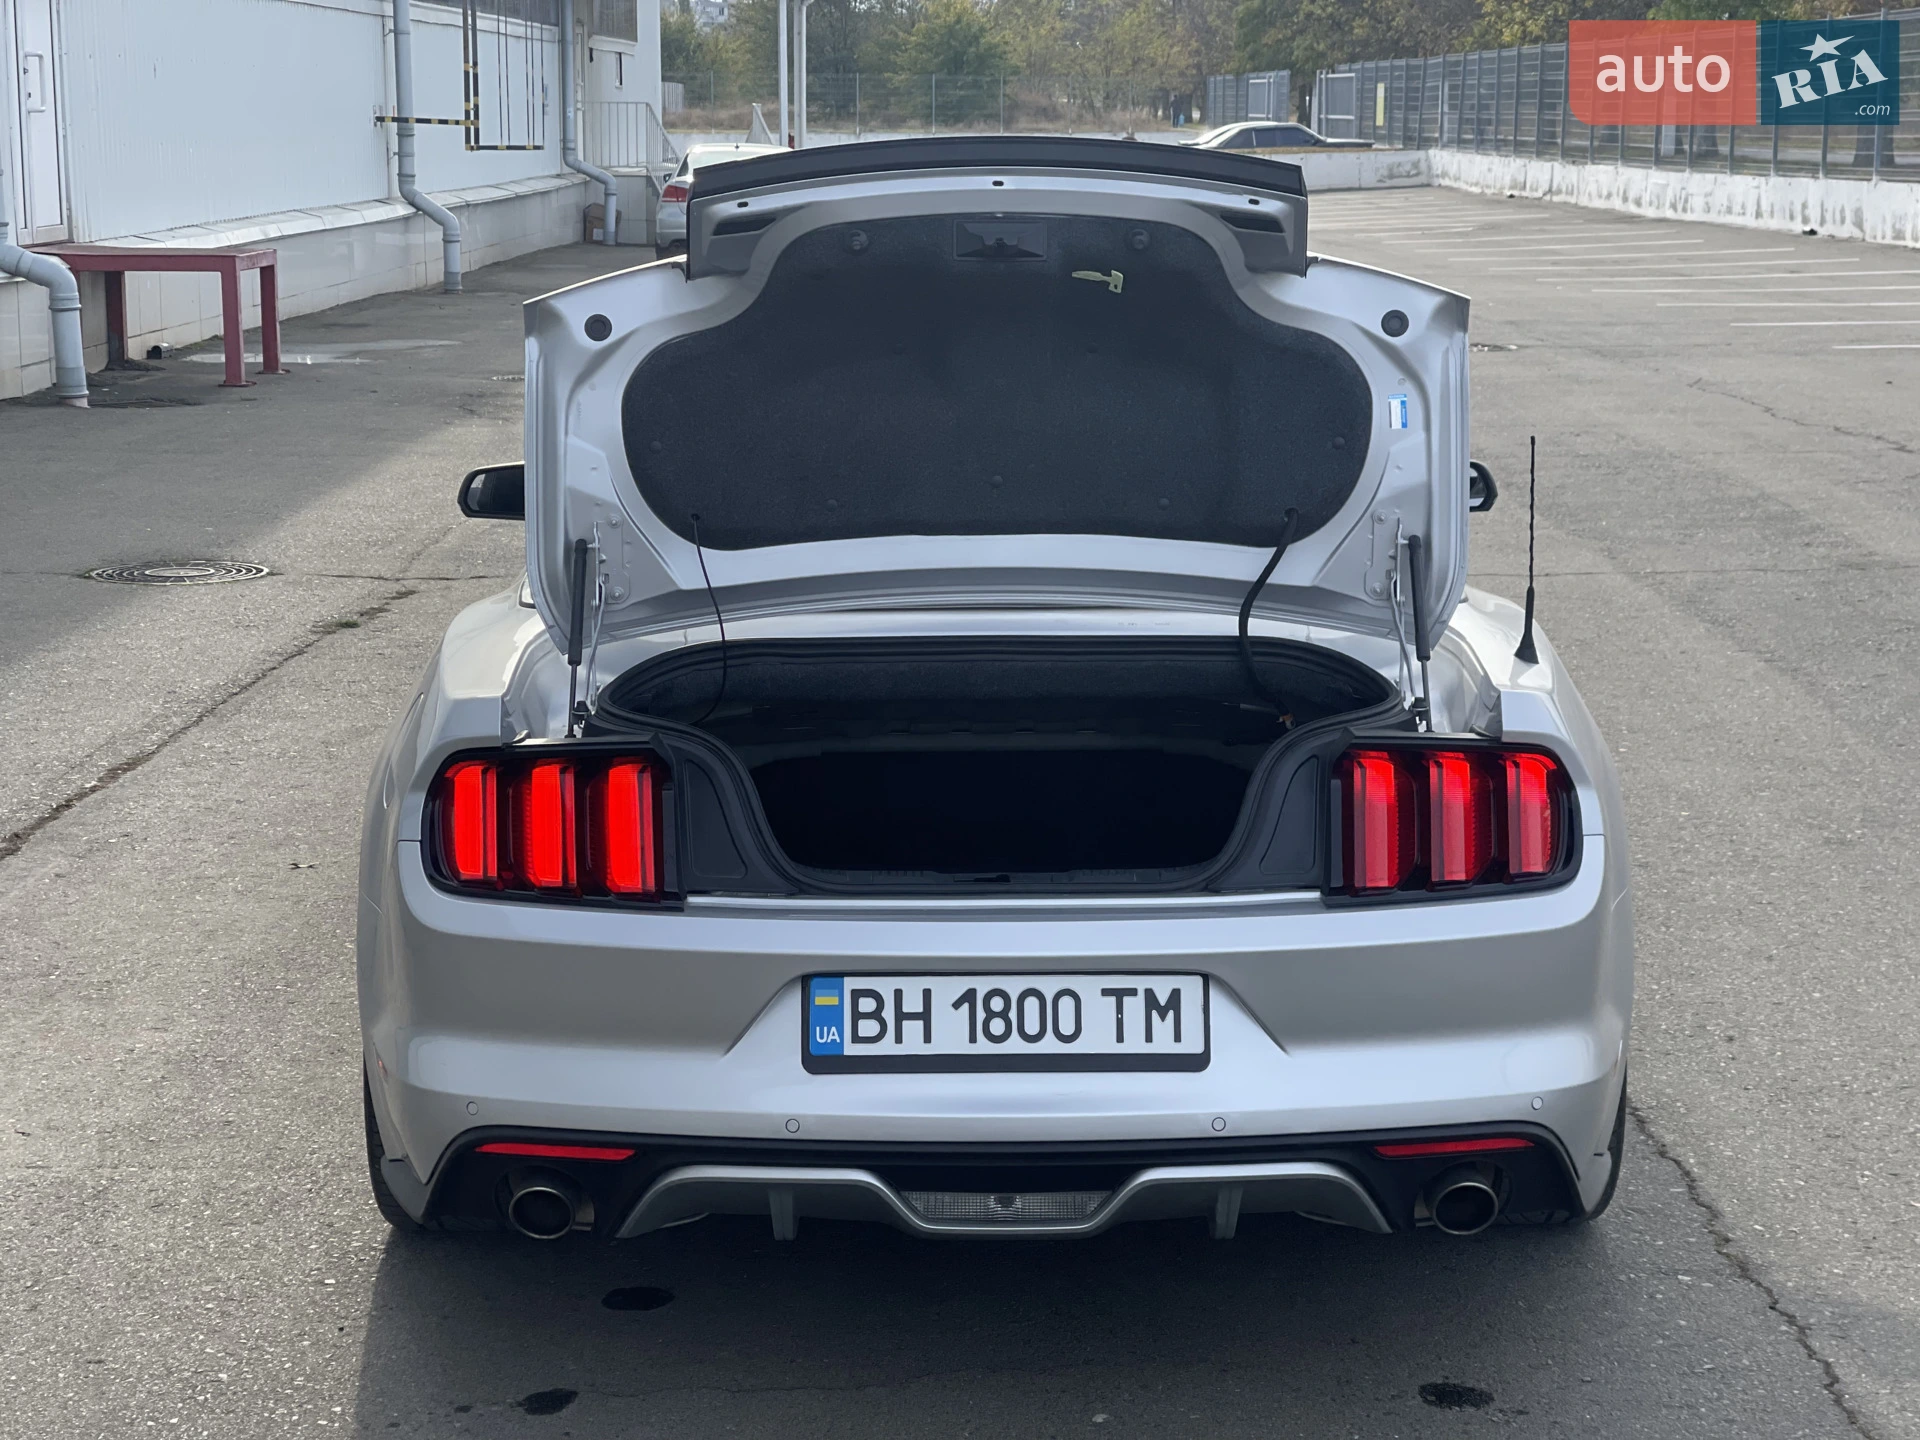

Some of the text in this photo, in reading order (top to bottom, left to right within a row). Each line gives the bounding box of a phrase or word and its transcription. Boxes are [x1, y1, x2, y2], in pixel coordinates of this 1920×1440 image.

[850, 988, 1182, 1044] BH 1800 TM
[816, 1026, 840, 1043] UA
